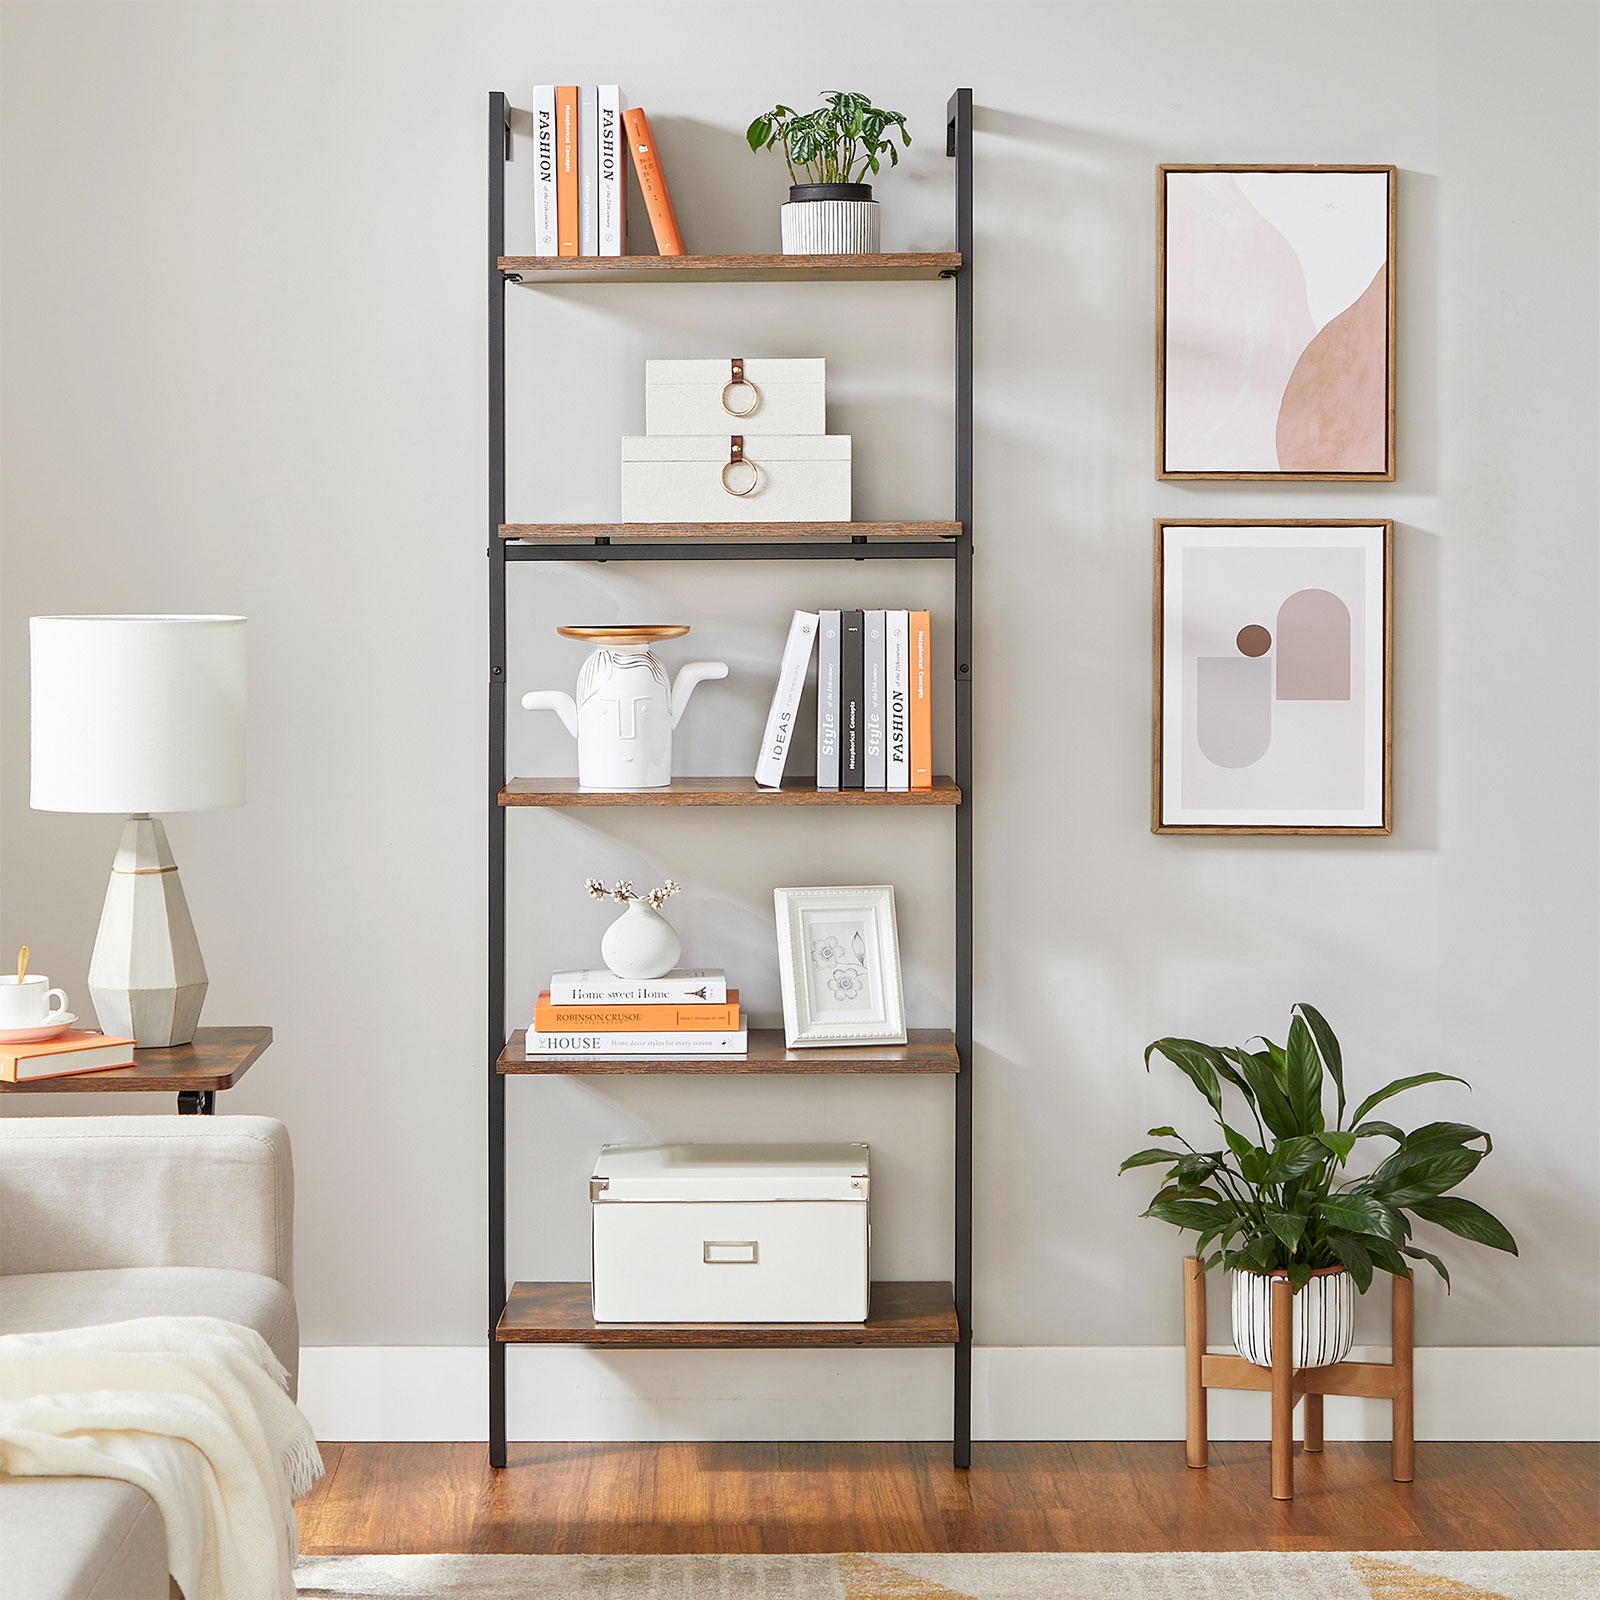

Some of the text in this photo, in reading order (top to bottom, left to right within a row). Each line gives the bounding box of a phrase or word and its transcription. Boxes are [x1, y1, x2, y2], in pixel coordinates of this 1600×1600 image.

[539, 110, 551, 182] FASHION
[603, 109, 614, 181] FASHION
[772, 712, 791, 761] IDEAS
[822, 713, 836, 756] Style
[868, 713, 882, 756] Style
[892, 690, 904, 763] FASHION
[572, 989, 670, 999] Home sweet Home
[548, 1037, 601, 1049] HOUSE
[647, 1040, 665, 1048] styles
